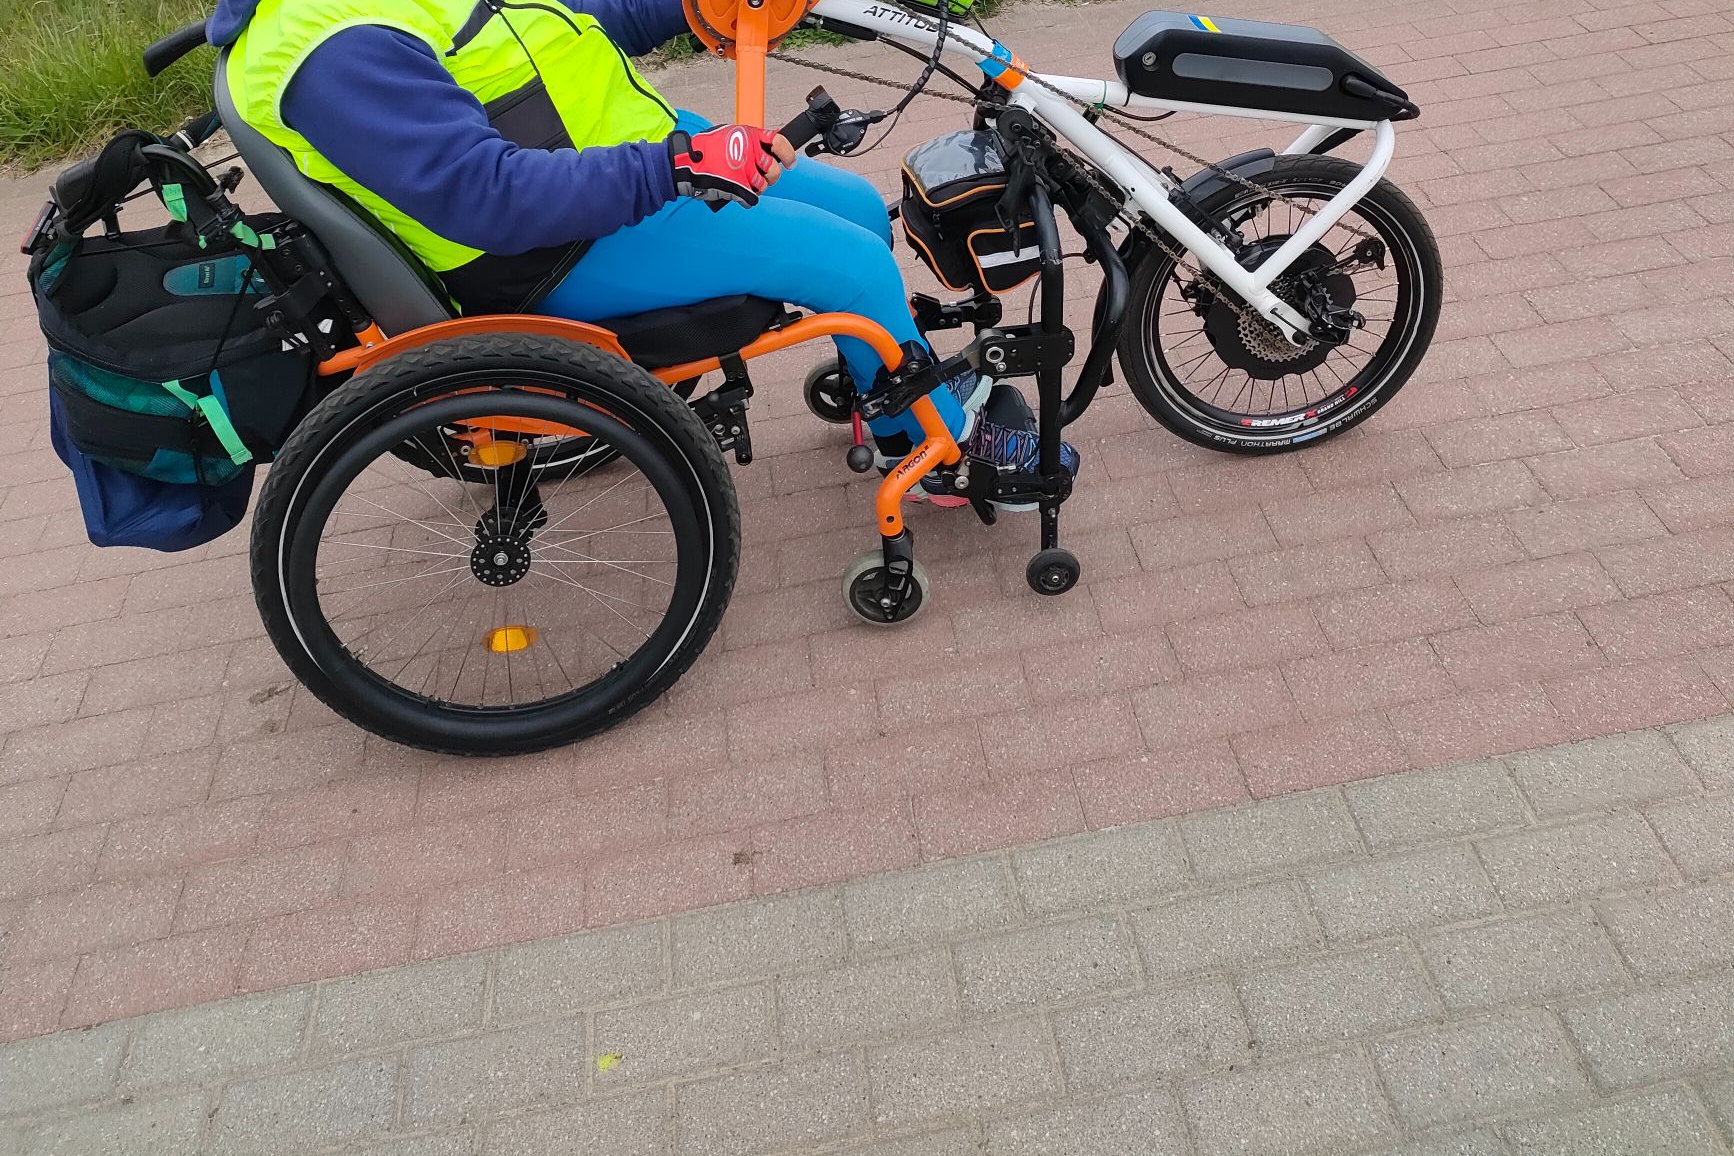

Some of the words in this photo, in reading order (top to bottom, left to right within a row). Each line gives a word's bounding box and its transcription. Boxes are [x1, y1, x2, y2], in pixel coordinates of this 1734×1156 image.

[1328, 396, 1378, 432] SCHWALBE
[1213, 434, 1238, 446] PLUS
[1240, 436, 1292, 448] MARATHON
